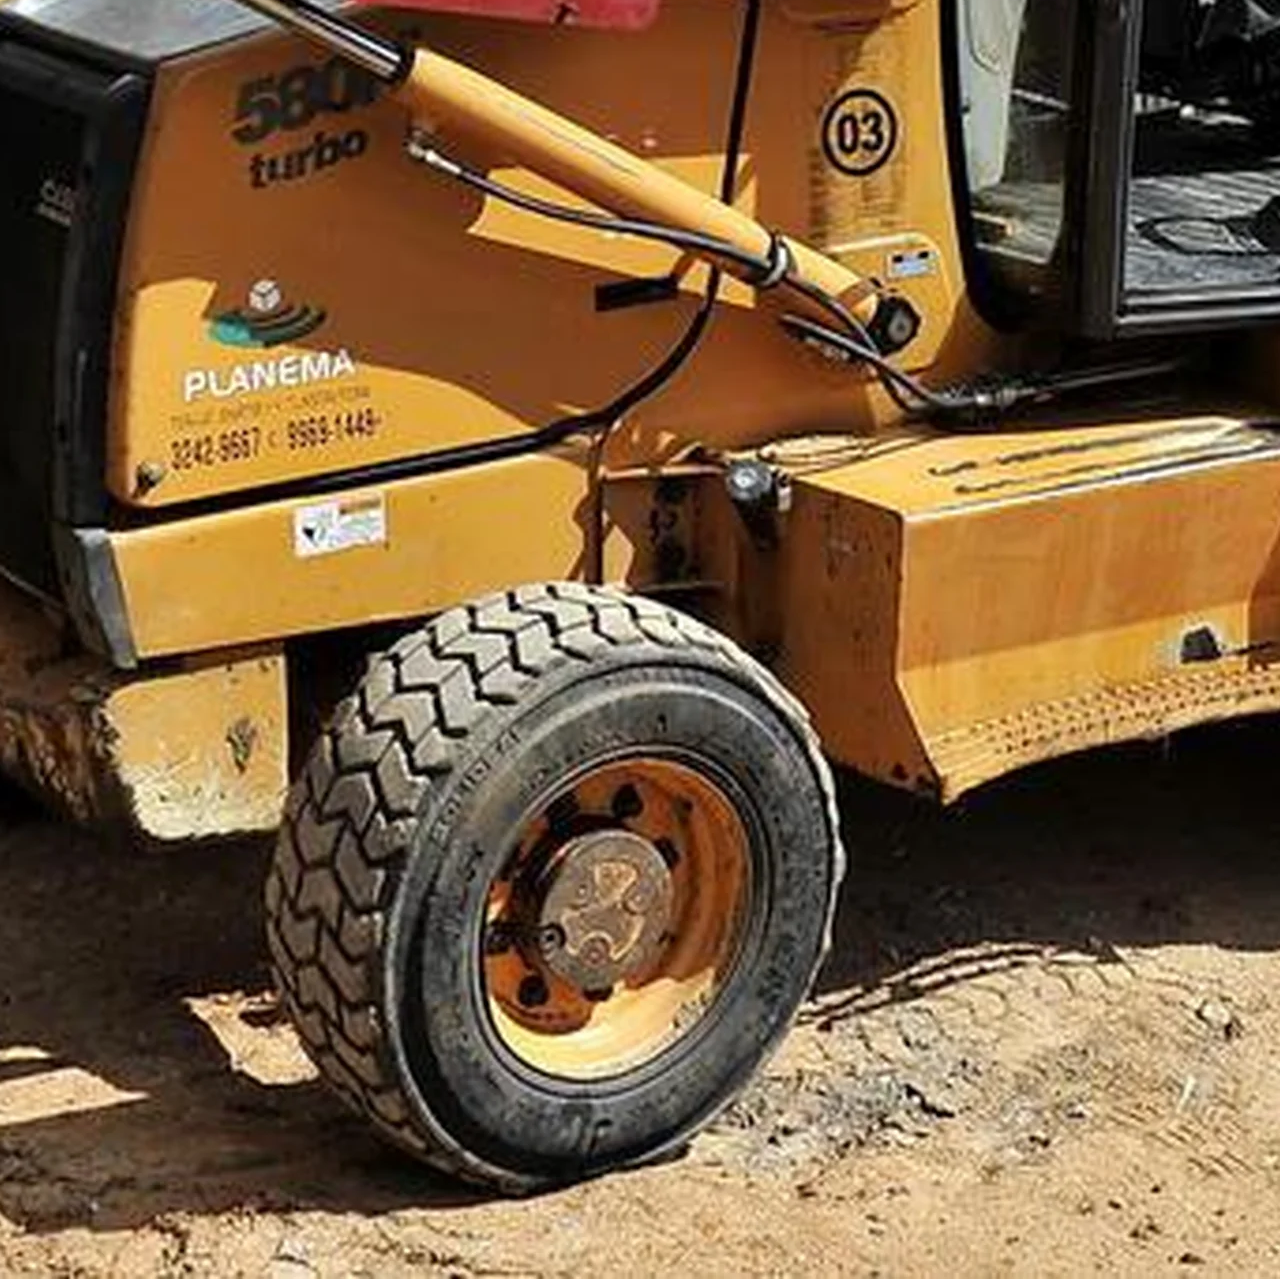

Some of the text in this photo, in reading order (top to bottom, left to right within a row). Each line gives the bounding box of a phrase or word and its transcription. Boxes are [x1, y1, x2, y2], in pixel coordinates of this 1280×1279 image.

[248, 128, 369, 190] turbo
[835, 109, 885, 154] 03
[182, 346, 357, 403] PLANEMA
